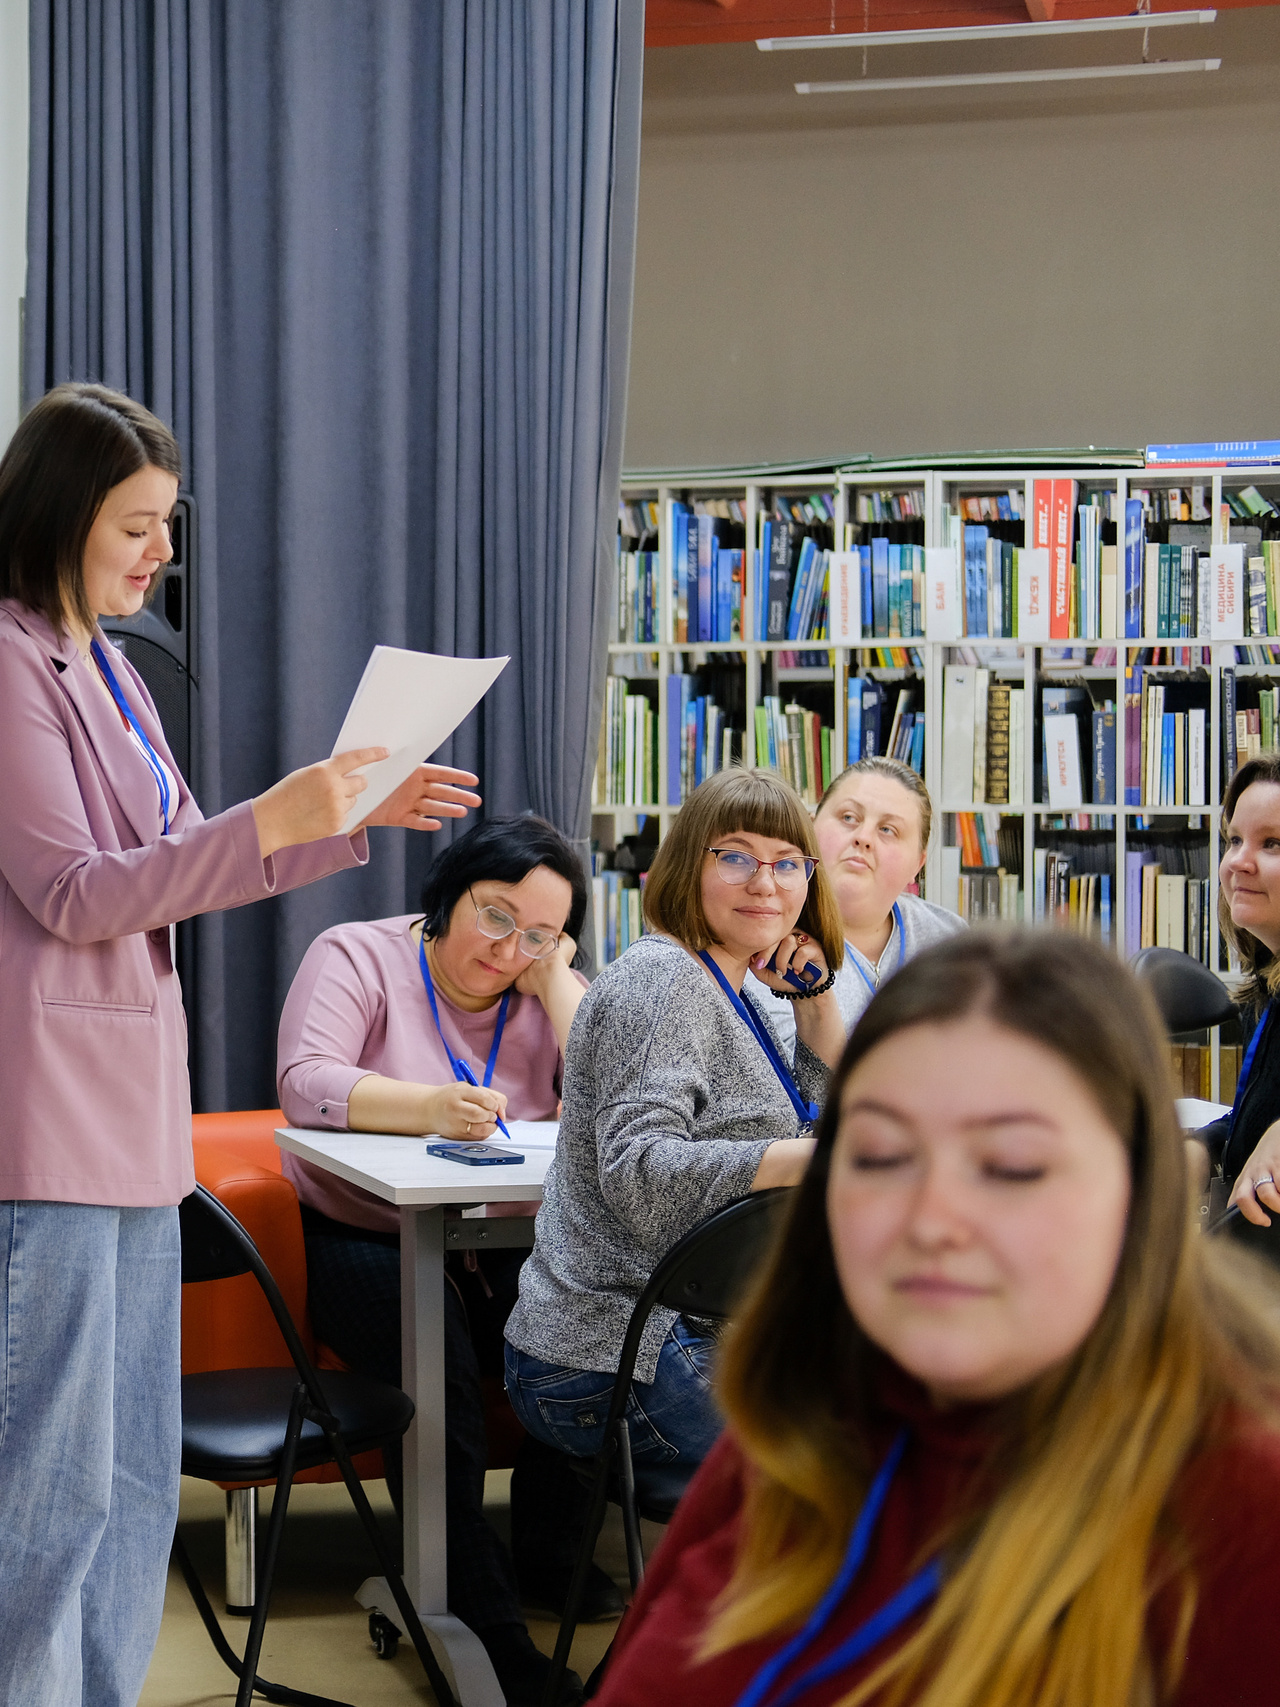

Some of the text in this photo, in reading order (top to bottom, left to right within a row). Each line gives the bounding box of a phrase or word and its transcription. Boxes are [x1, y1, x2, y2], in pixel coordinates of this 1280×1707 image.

[935, 581, 946, 611] БАМ
[1217, 563, 1226, 623] МЕДИЦИНА
[1226, 571, 1235, 614] СИБИРИ
